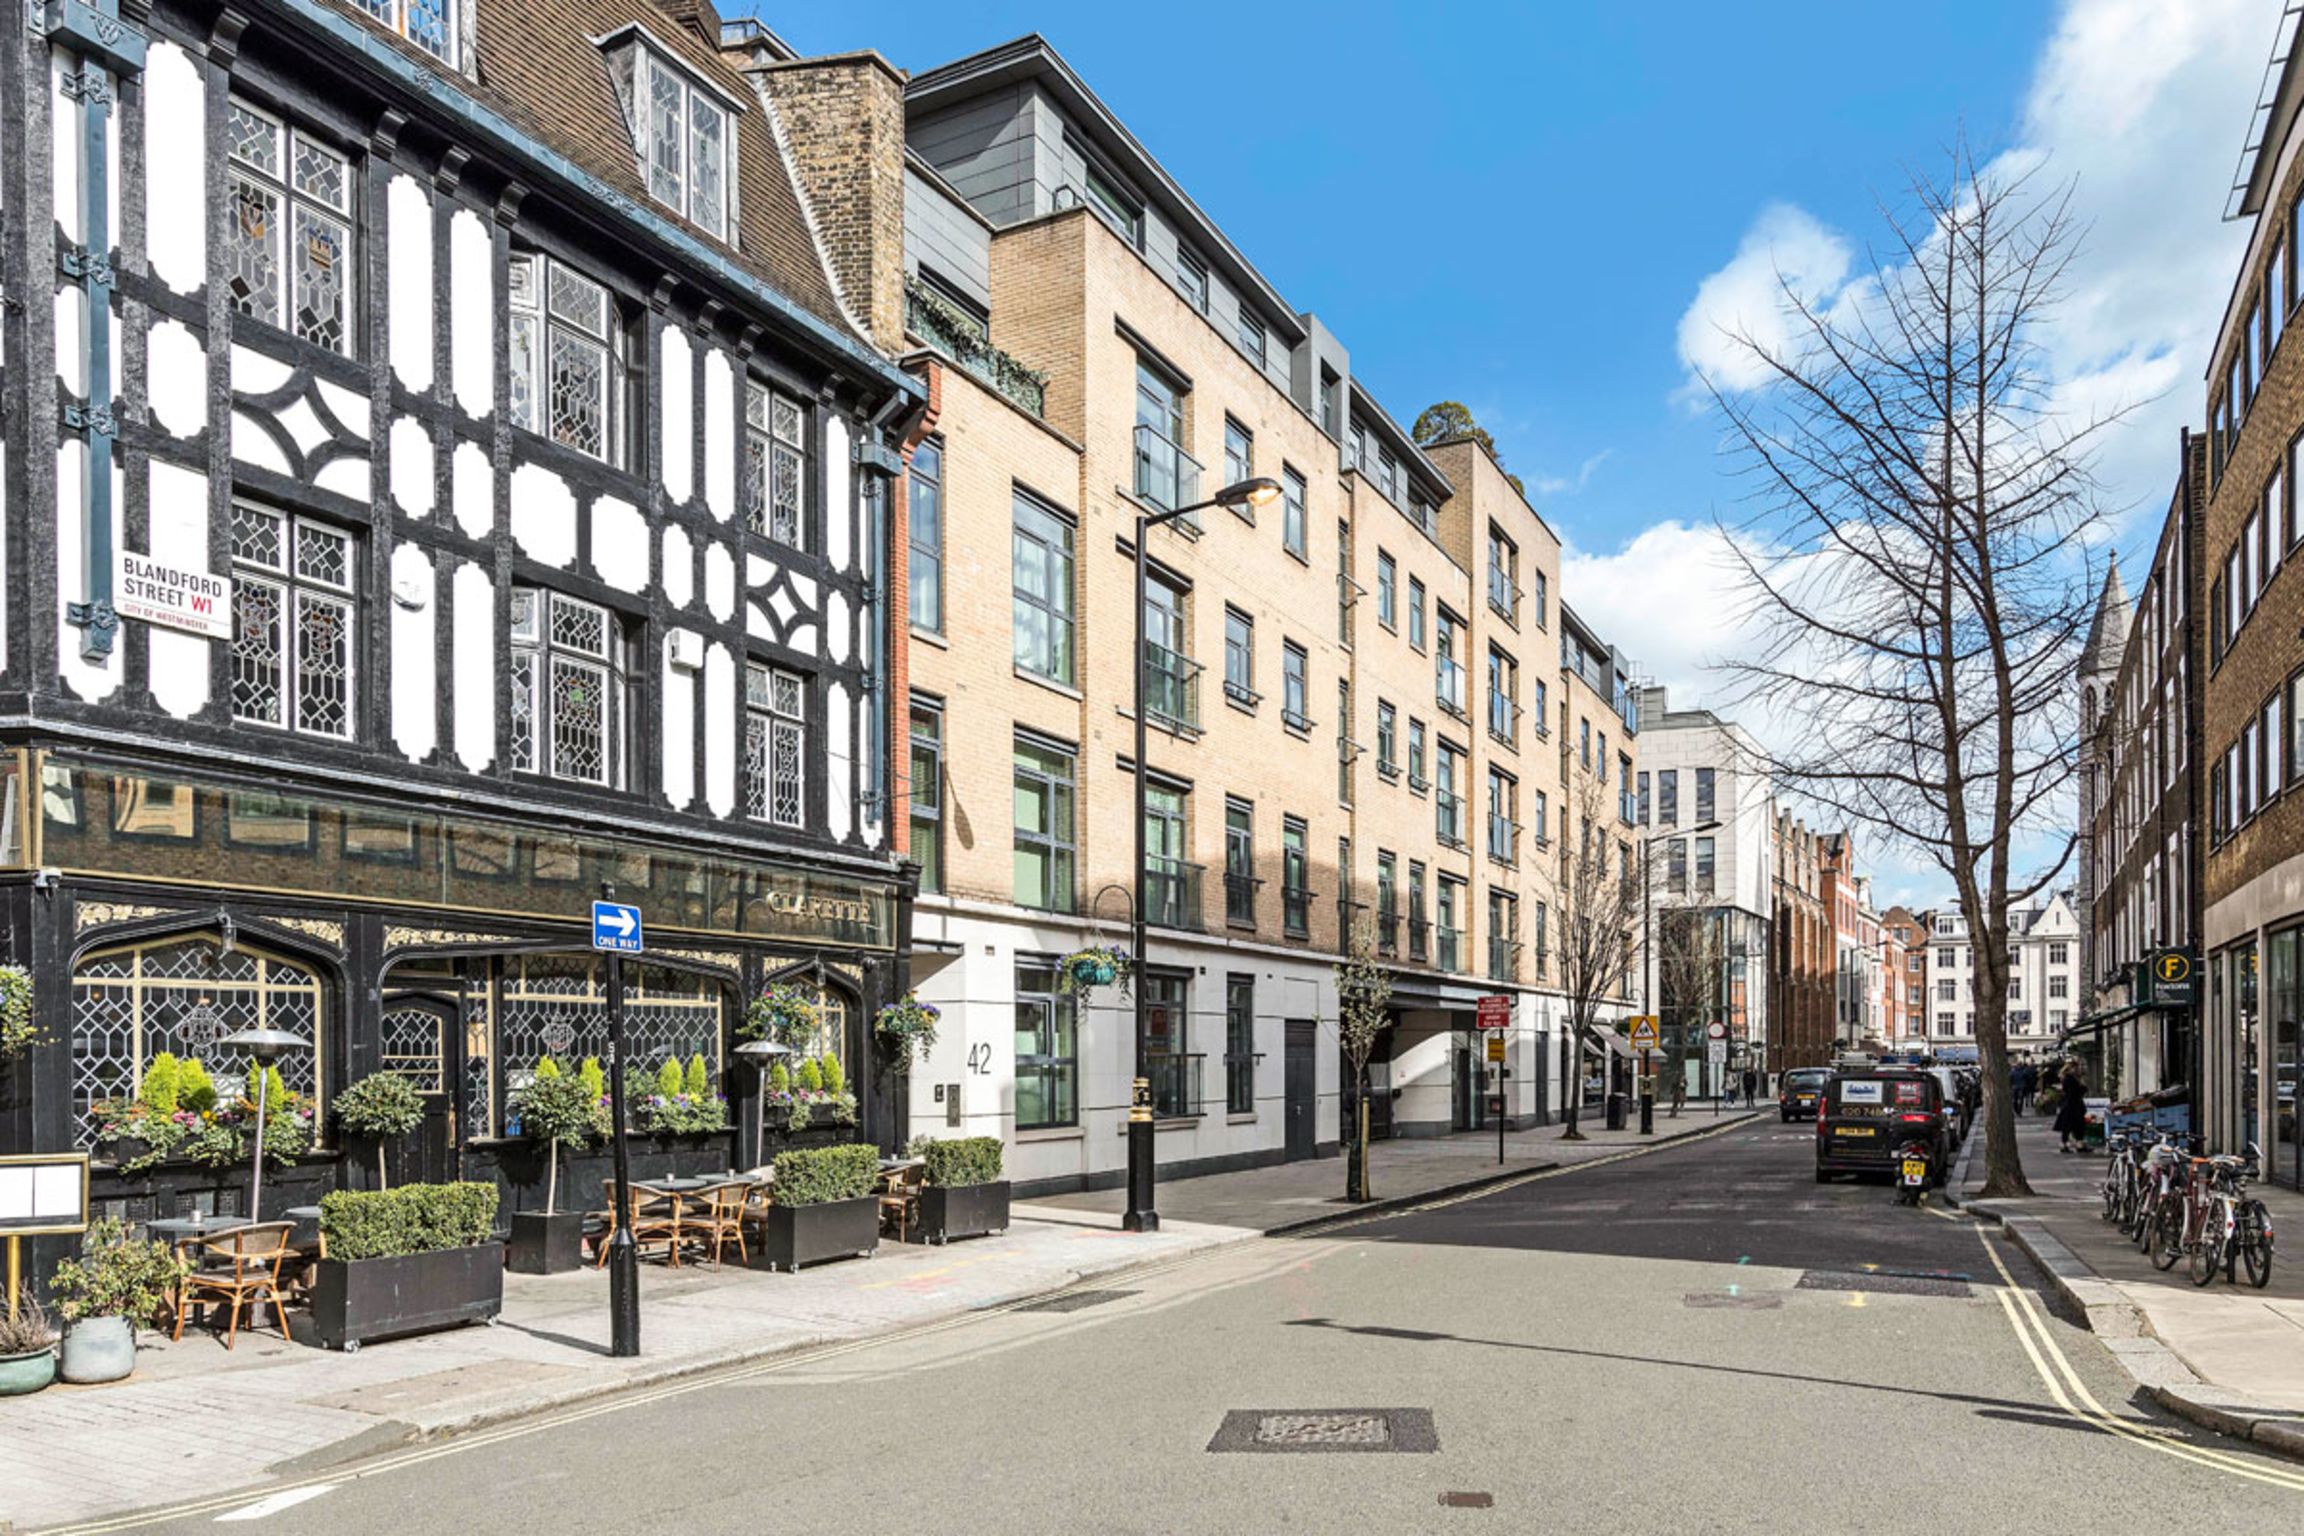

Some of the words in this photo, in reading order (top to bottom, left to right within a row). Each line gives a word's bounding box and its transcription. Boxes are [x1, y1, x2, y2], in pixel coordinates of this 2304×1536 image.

[124, 558, 221, 597] BLANDFORD
[124, 577, 185, 607] STREET
[191, 594, 213, 615] W1
[598, 936, 617, 947] ONE
[619, 939, 638, 949] WAY
[2165, 958, 2179, 978] F
[967, 1042, 992, 1075] 42
